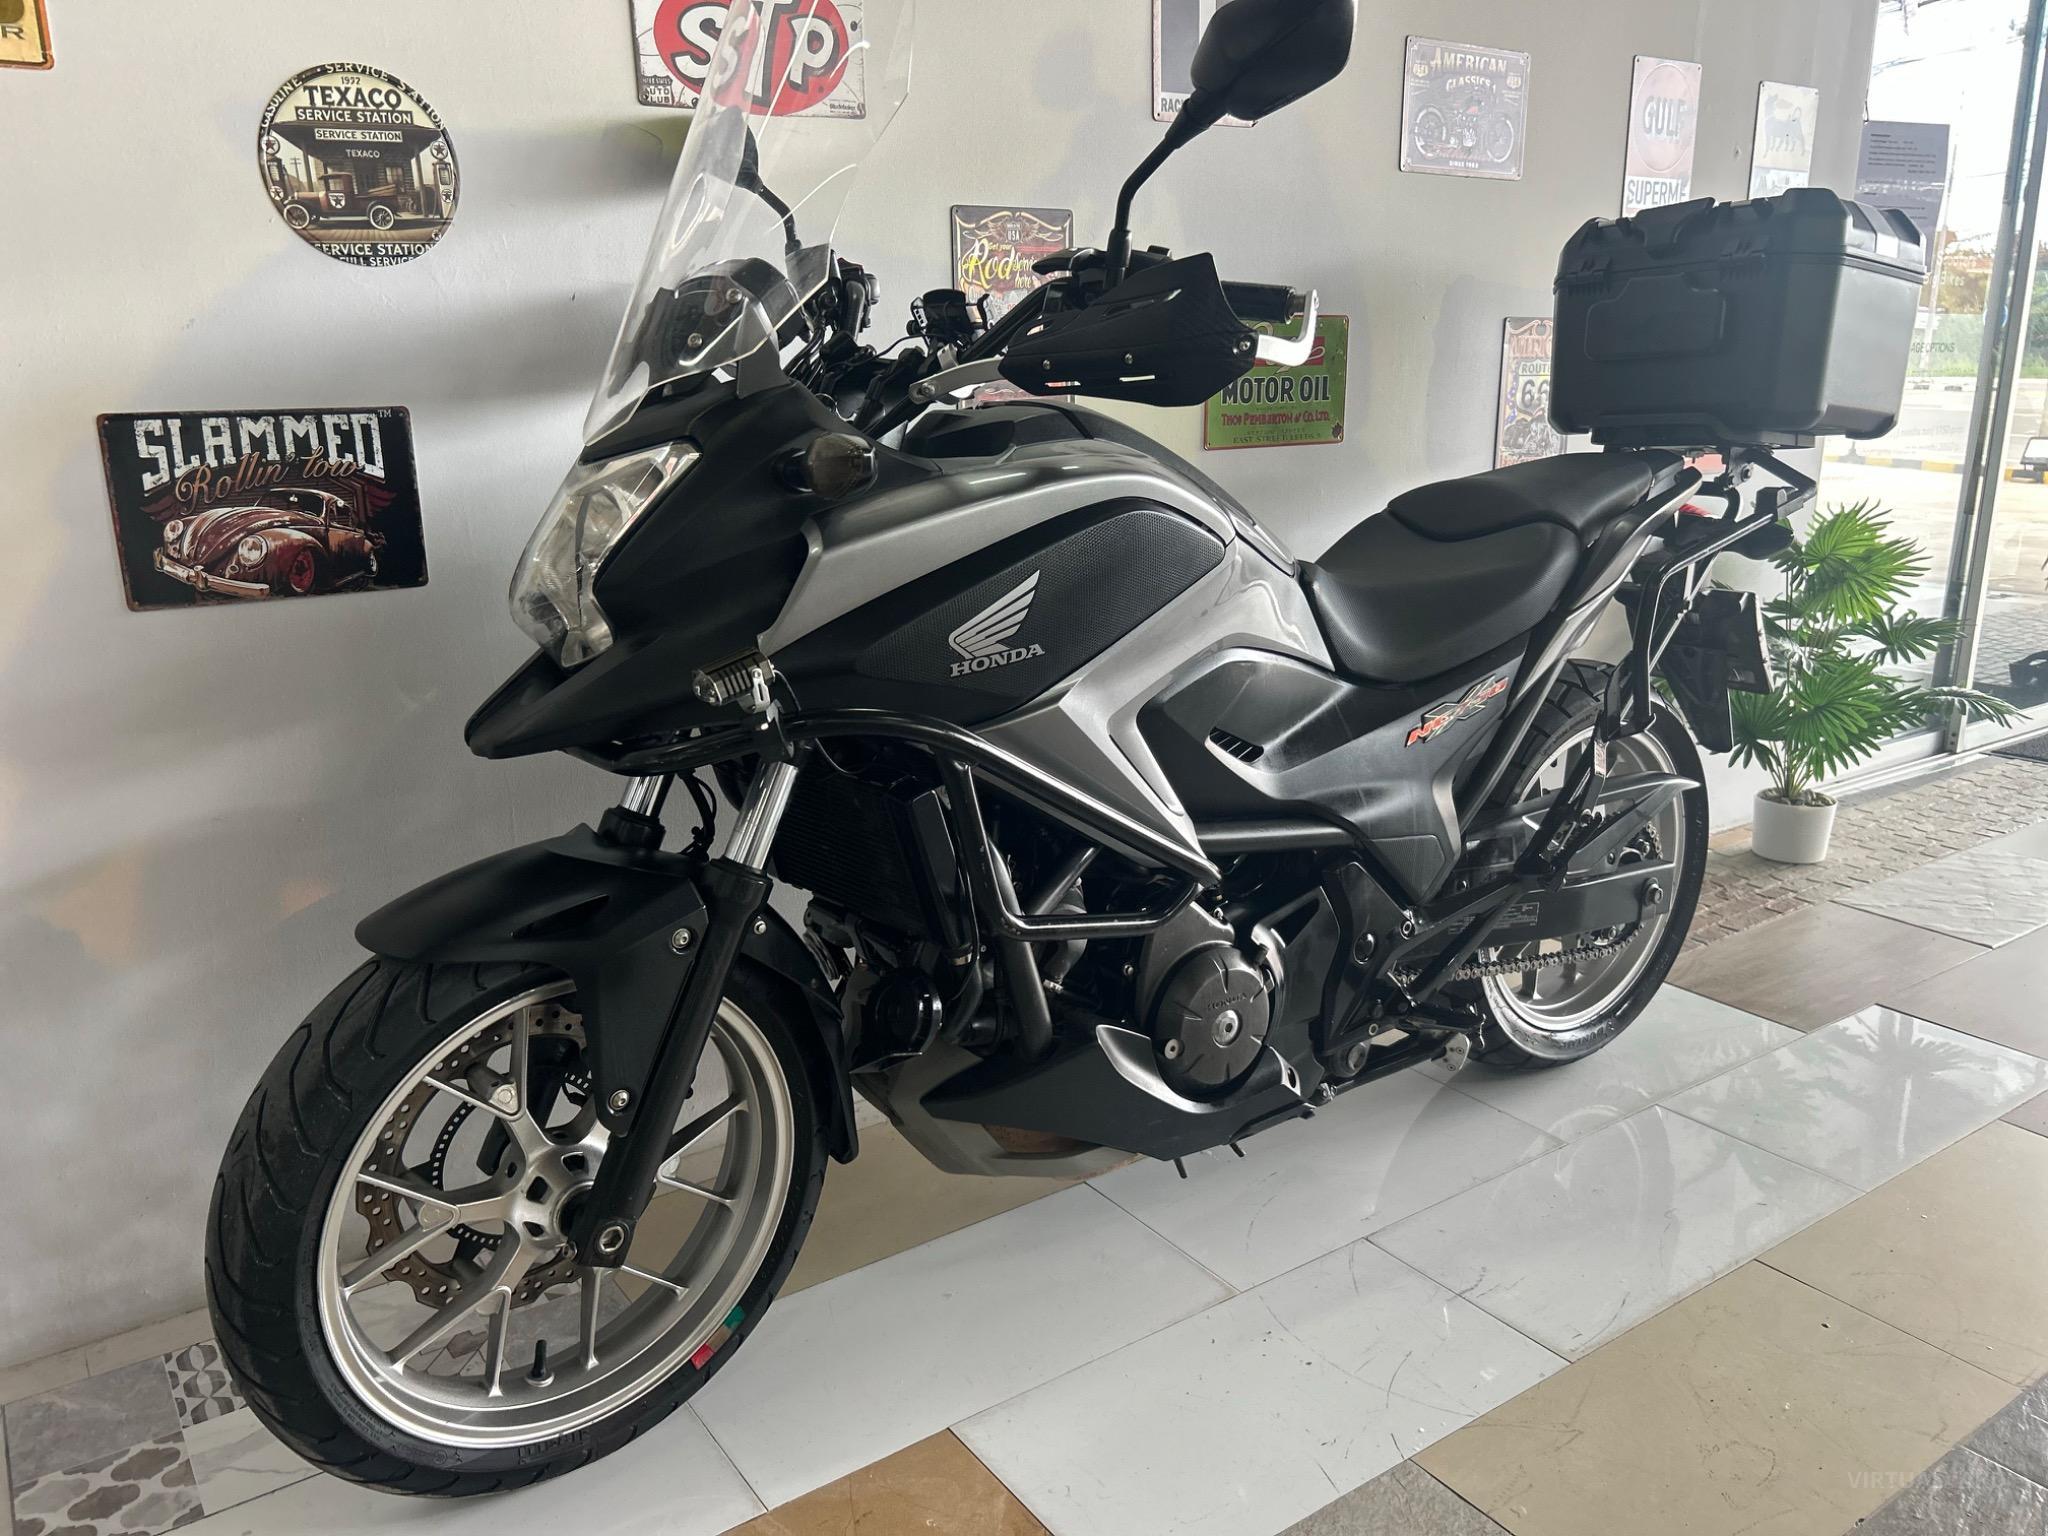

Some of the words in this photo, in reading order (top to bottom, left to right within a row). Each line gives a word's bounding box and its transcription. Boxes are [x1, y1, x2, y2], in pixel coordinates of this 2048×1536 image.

[1430, 47, 1507, 73] AMERICAN
[325, 62, 389, 82] SERVICE
[1446, 75, 1491, 92] CLASSICS
[302, 85, 402, 110] TEXACO
[648, 96, 670, 104] LUB
[297, 108, 352, 122] SERVICE
[356, 111, 413, 124] STATION
[1643, 97, 1687, 138] GULF
[316, 129, 357, 140] SERVICE
[361, 131, 402, 141] STATION
[345, 149, 380, 159] TEXACO
[377, 243, 433, 255] STATION
[962, 238, 1016, 289] Rod
[1910, 342, 1925, 353] AGE
[1221, 376, 1295, 405] MOTOR
[1300, 375, 1331, 403] OIL
[134, 413, 386, 491] SLAMMED
[301, 445, 366, 481] low
[950, 643, 1046, 677] HONDA
